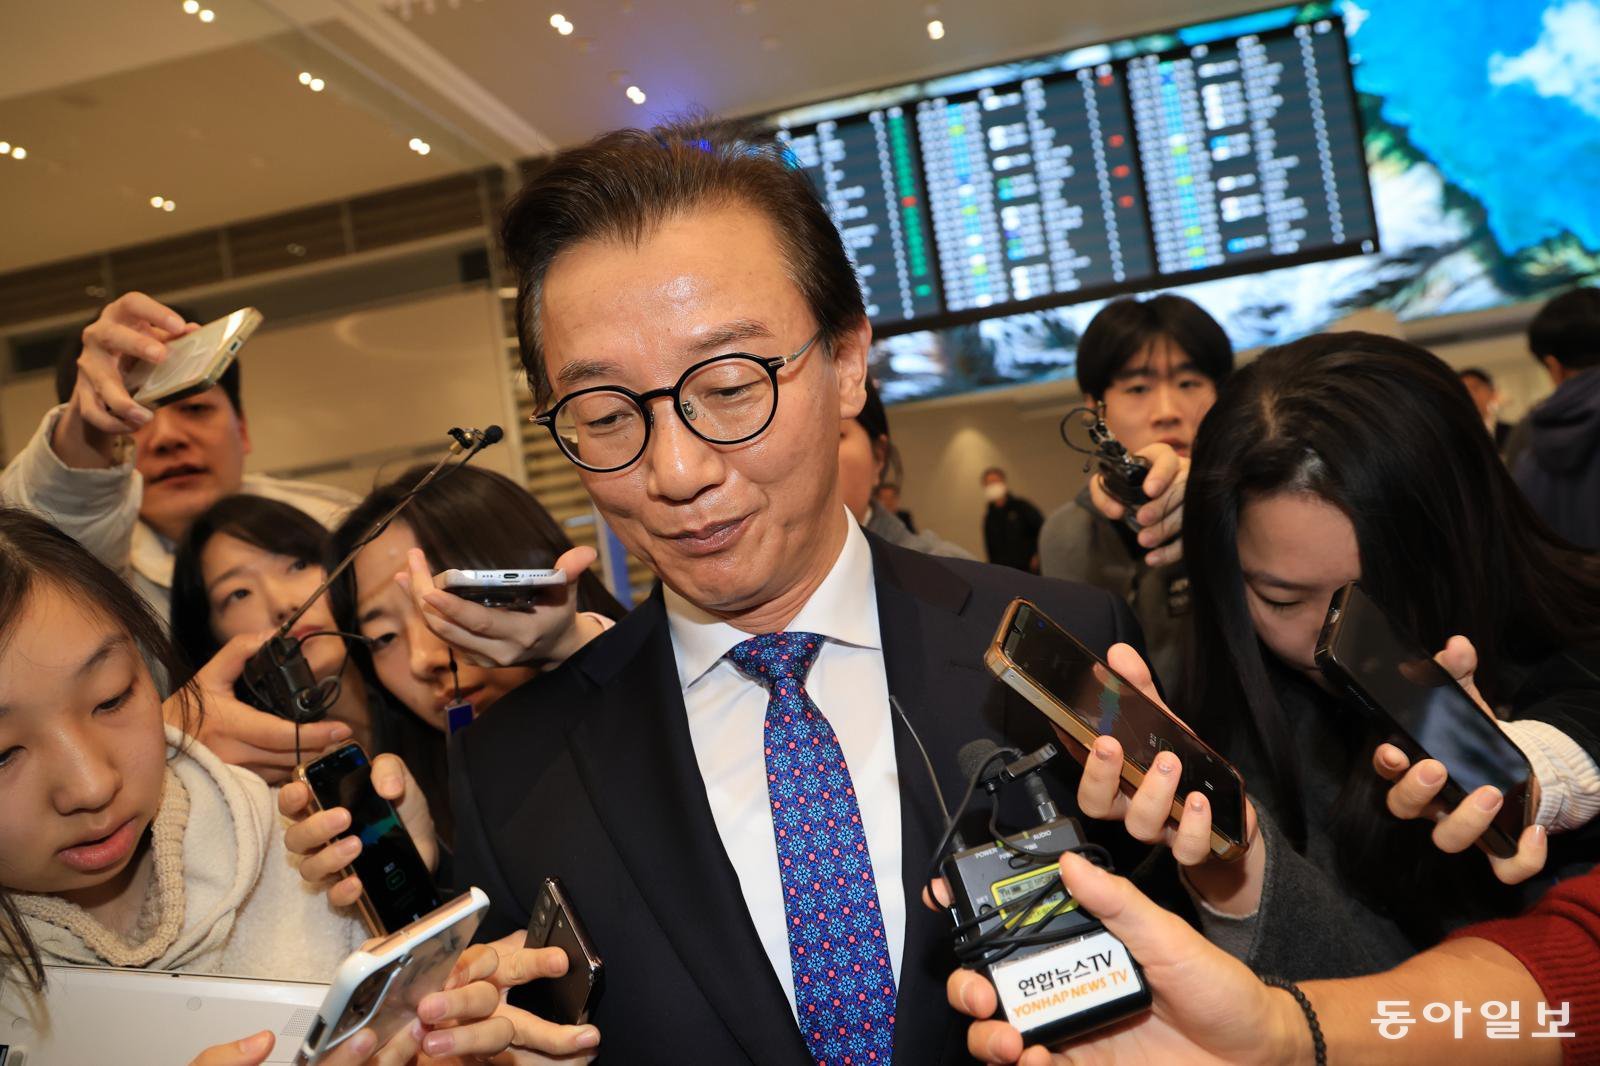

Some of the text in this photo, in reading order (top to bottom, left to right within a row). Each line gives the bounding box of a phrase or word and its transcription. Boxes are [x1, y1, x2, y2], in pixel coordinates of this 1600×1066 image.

[1033, 830, 1052, 840] AUDIO
[975, 847, 998, 859] POWER
[1018, 950, 1112, 998] 연합뉴스TV
[1109, 968, 1129, 985] TV
